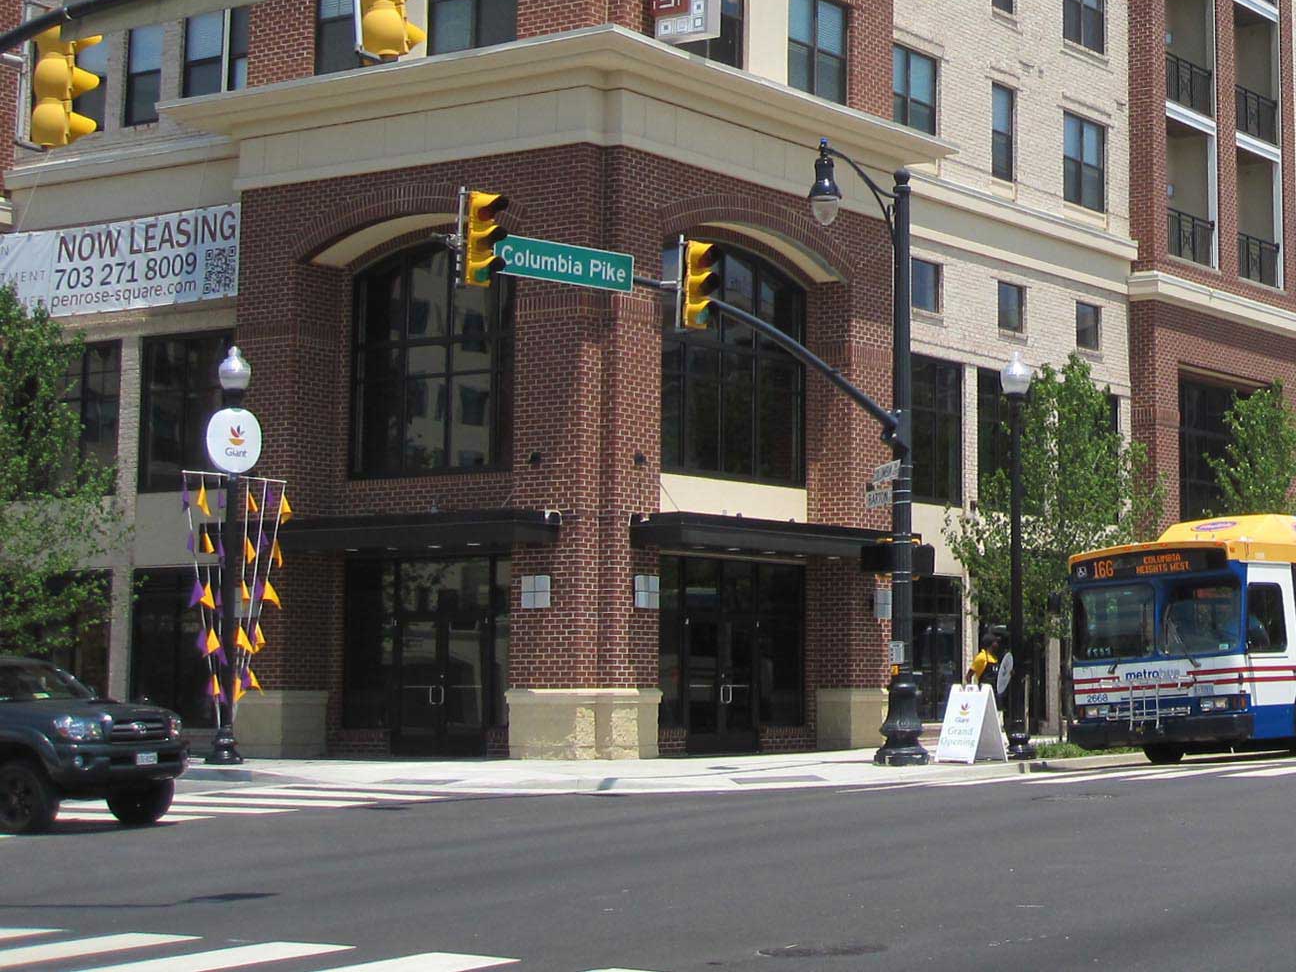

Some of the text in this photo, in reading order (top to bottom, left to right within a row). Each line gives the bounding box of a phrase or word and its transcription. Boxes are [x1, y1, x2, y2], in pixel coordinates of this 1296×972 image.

[57, 210, 237, 263] NOW LEASING
[54, 252, 198, 290] 703 271 8009
[501, 245, 626, 283] Columbia Pike
[51, 279, 197, 313] penrose-square.com
[224, 447, 248, 458] Giant
[1136, 561, 1190, 574] HEIGHTS WEST
[1143, 553, 1181, 564] COLUMBIA
